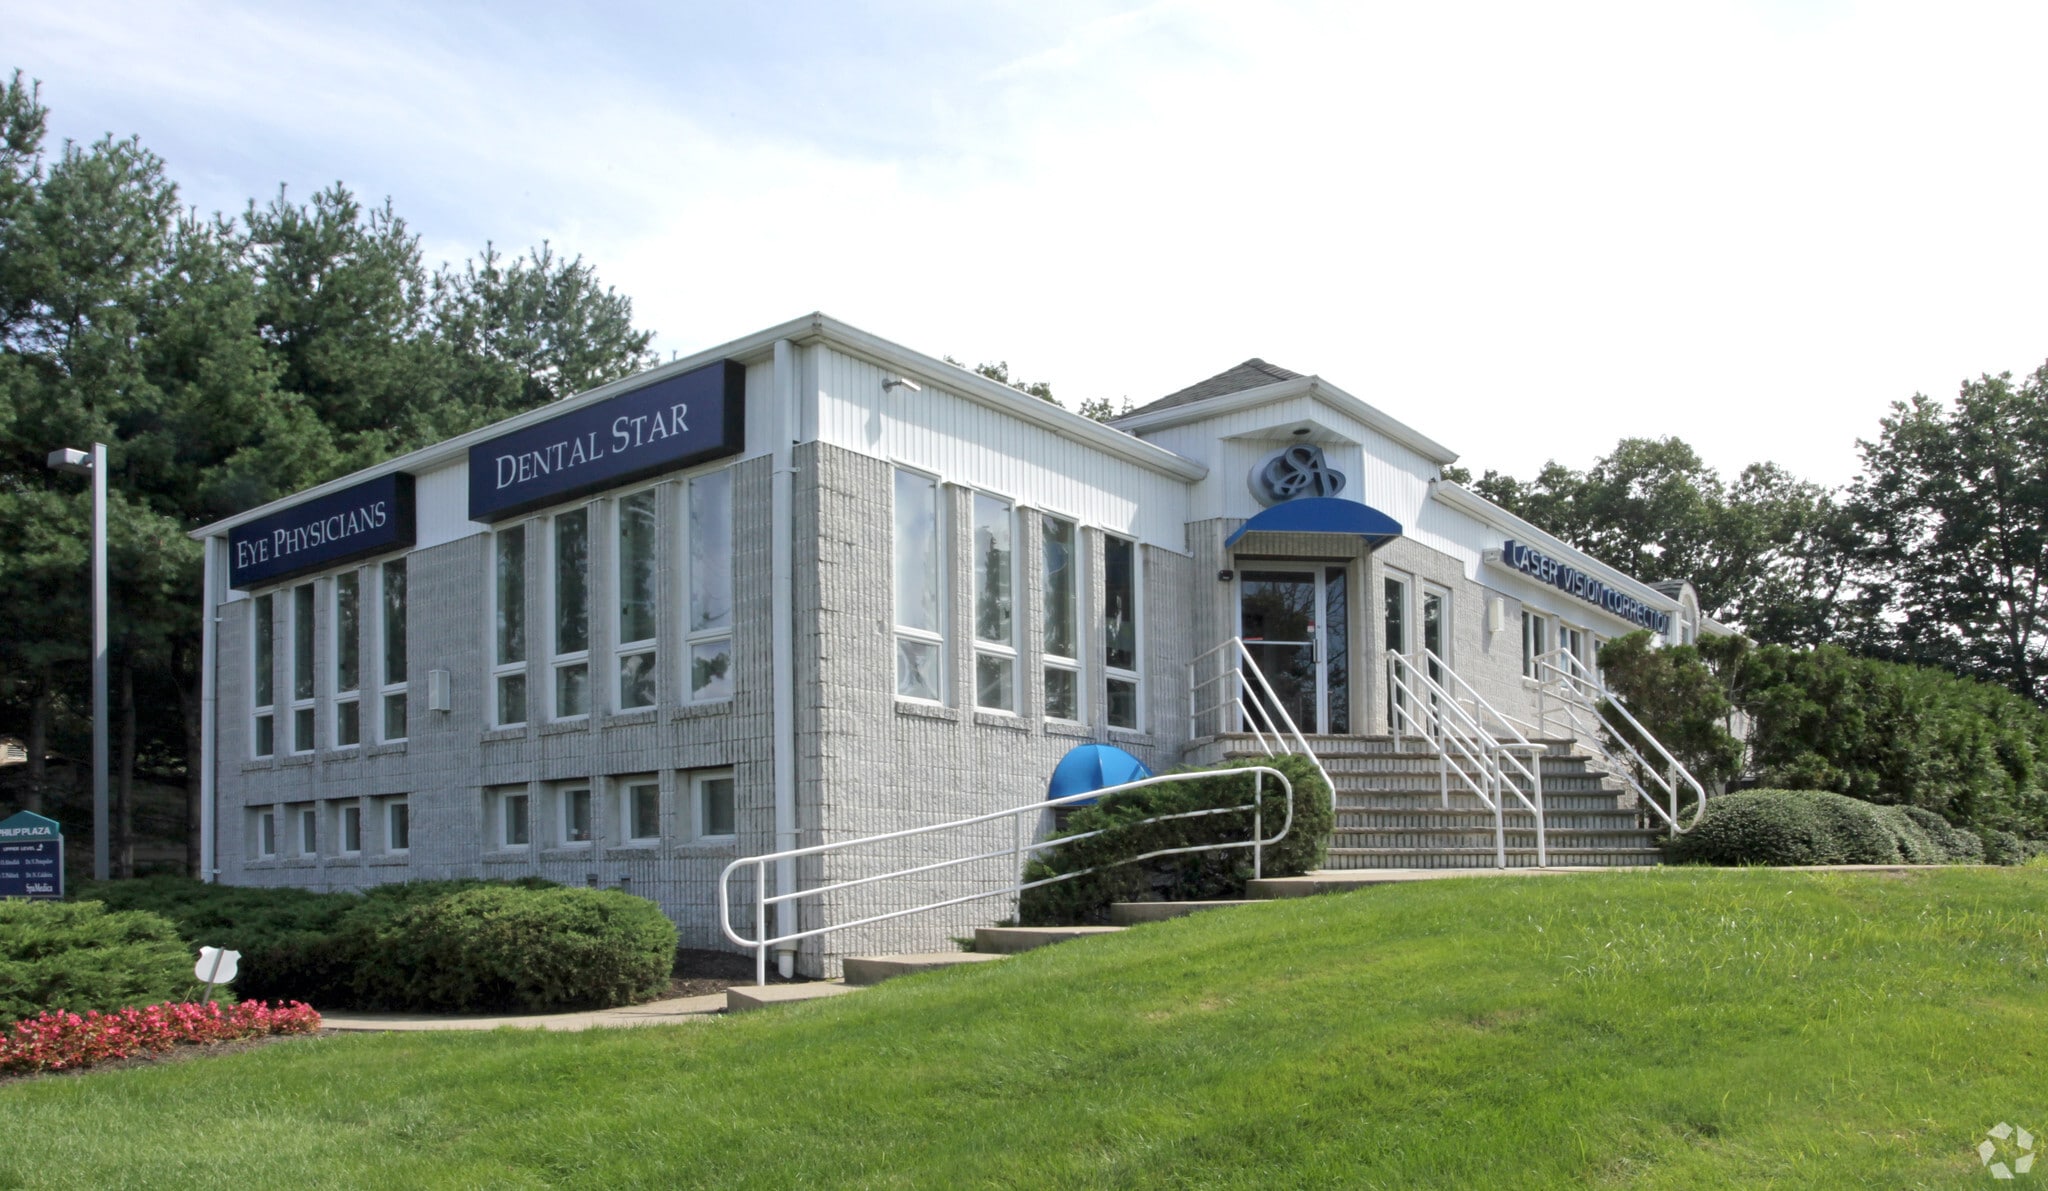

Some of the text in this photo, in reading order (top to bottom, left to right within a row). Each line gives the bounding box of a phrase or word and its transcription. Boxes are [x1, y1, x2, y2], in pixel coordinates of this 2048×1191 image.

[494, 402, 690, 490] DENTAL STAR
[236, 501, 387, 570] EYE PHYSICIANS
[1511, 541, 1558, 585] LASER
[1563, 567, 1604, 604] VISION
[21, 827, 51, 836] PLAZA
